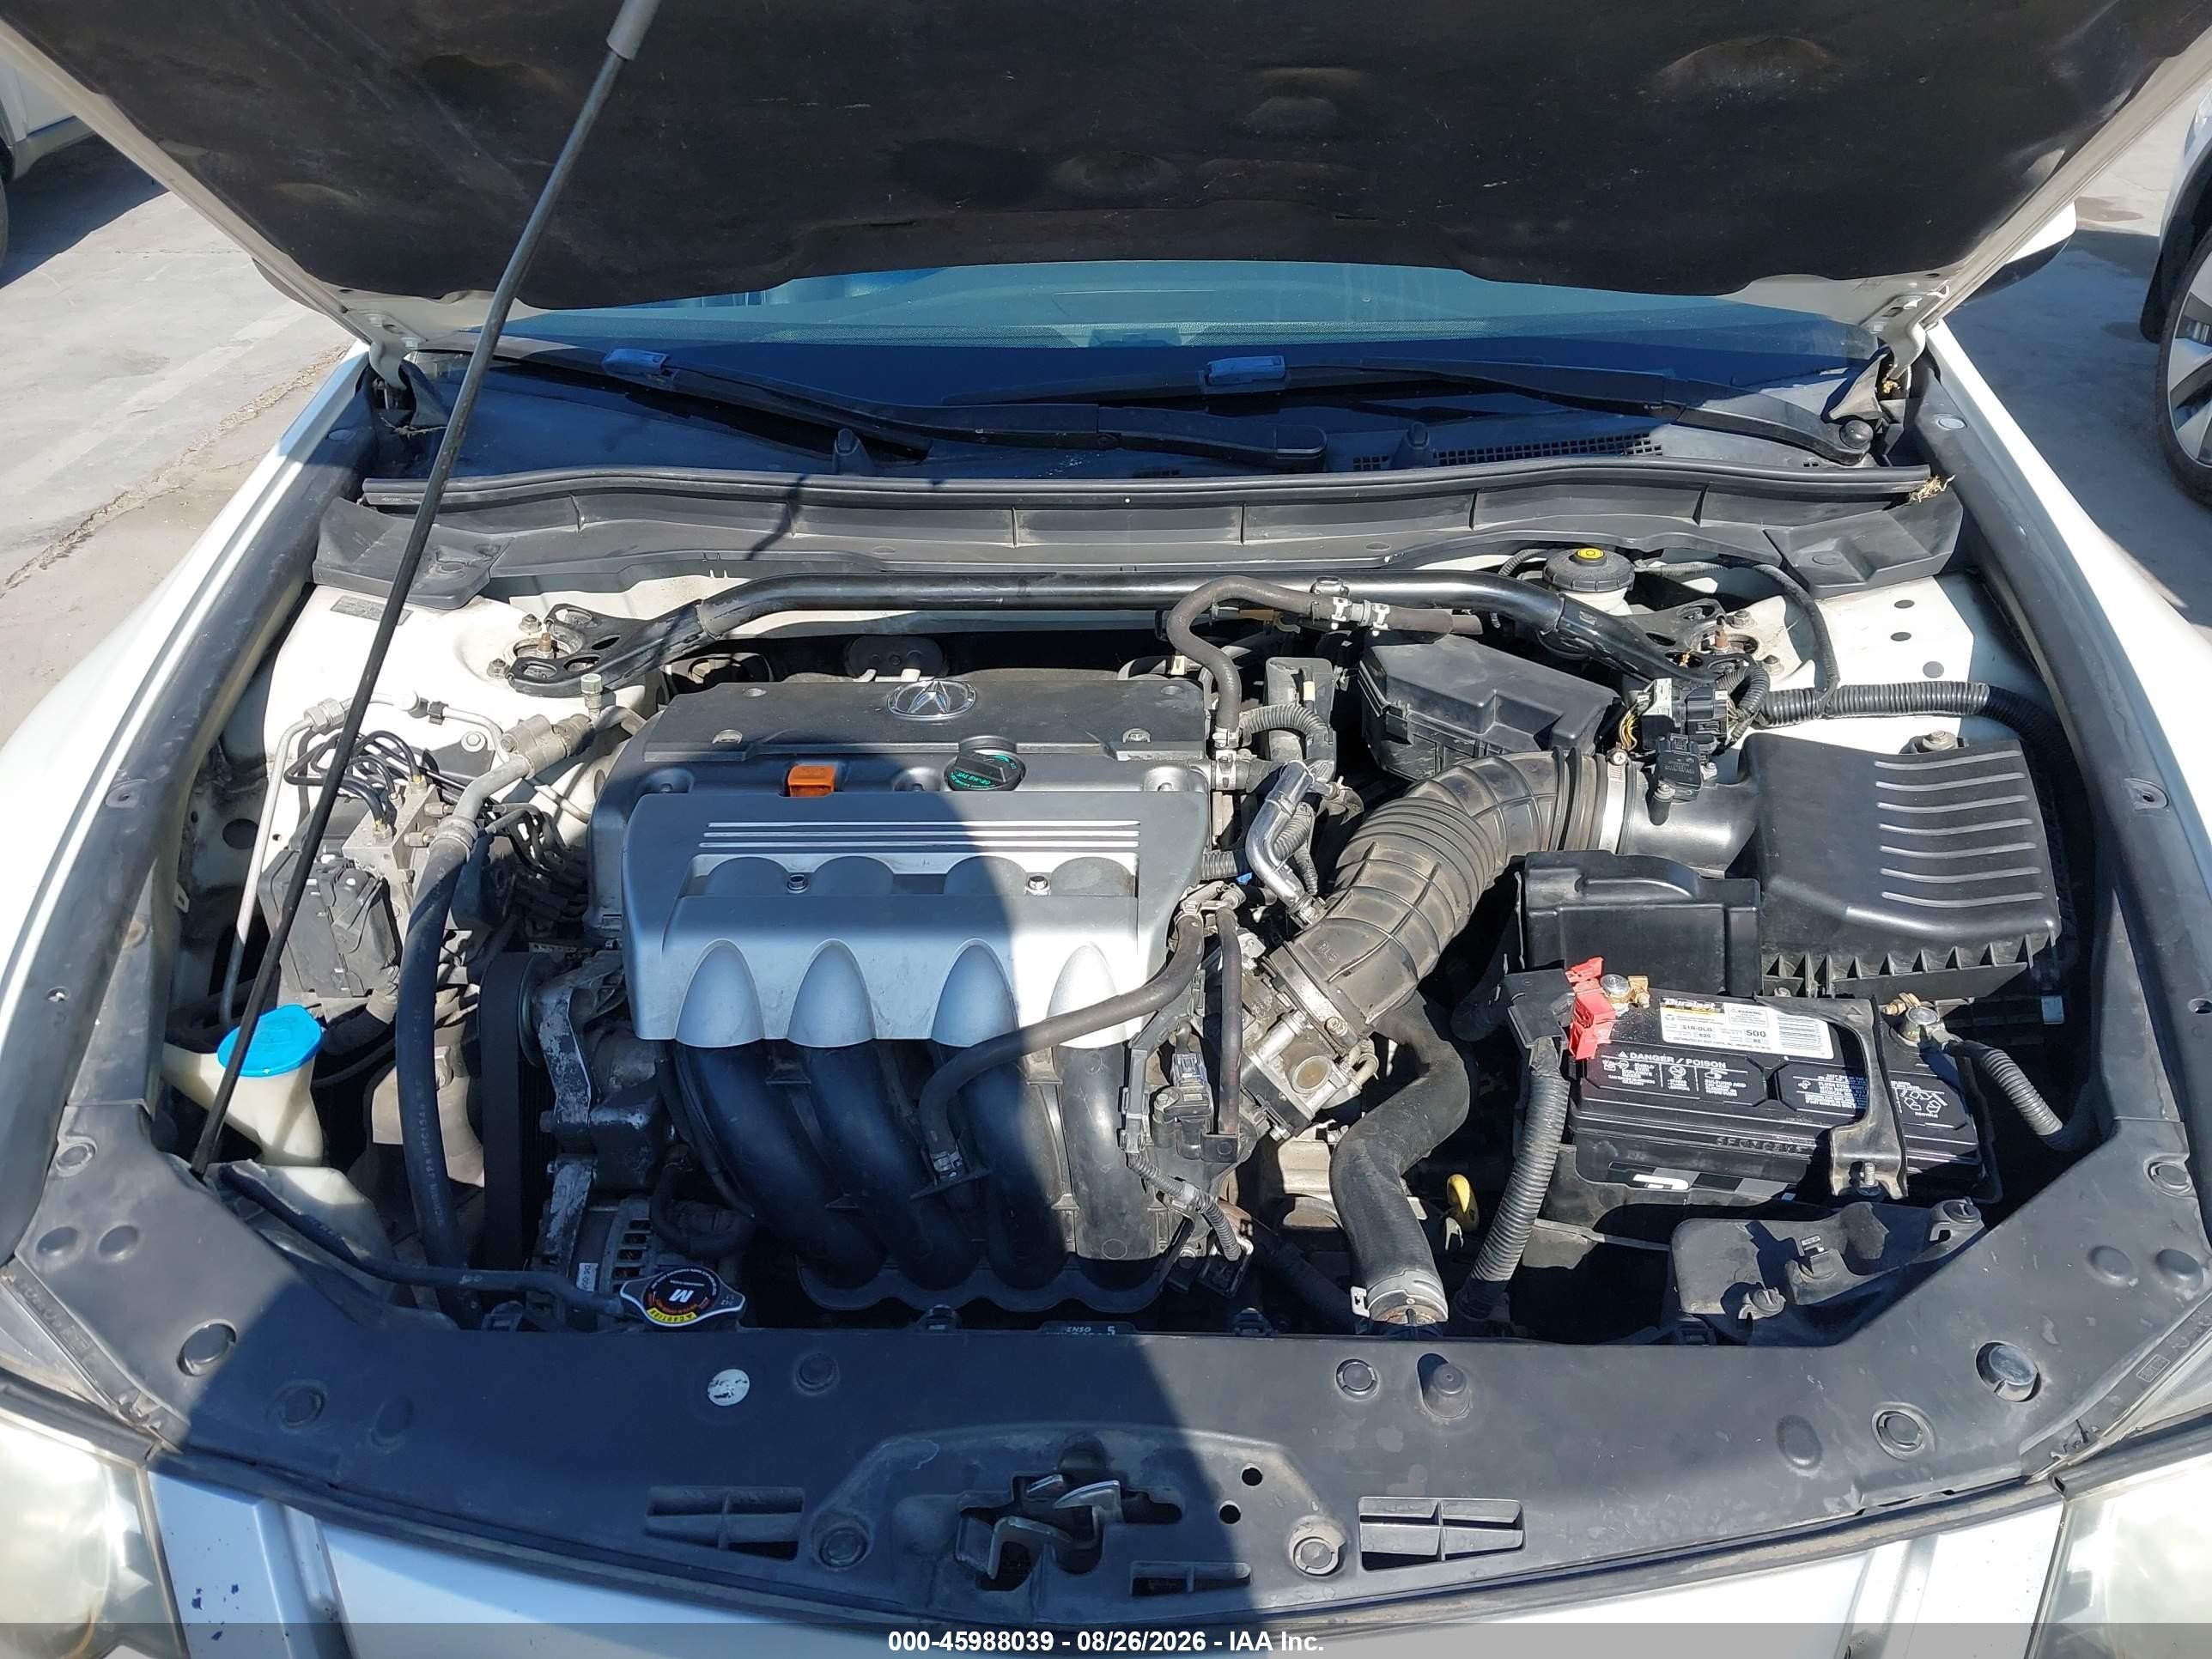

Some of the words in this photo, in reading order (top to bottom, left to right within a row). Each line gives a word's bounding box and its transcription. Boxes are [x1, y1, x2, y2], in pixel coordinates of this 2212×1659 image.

[1630, 1052, 1674, 1063] DANGER
[1686, 1058, 1727, 1069] POISON
[669, 1288, 694, 1304] M
[649, 1310, 685, 1323] CAUTION
